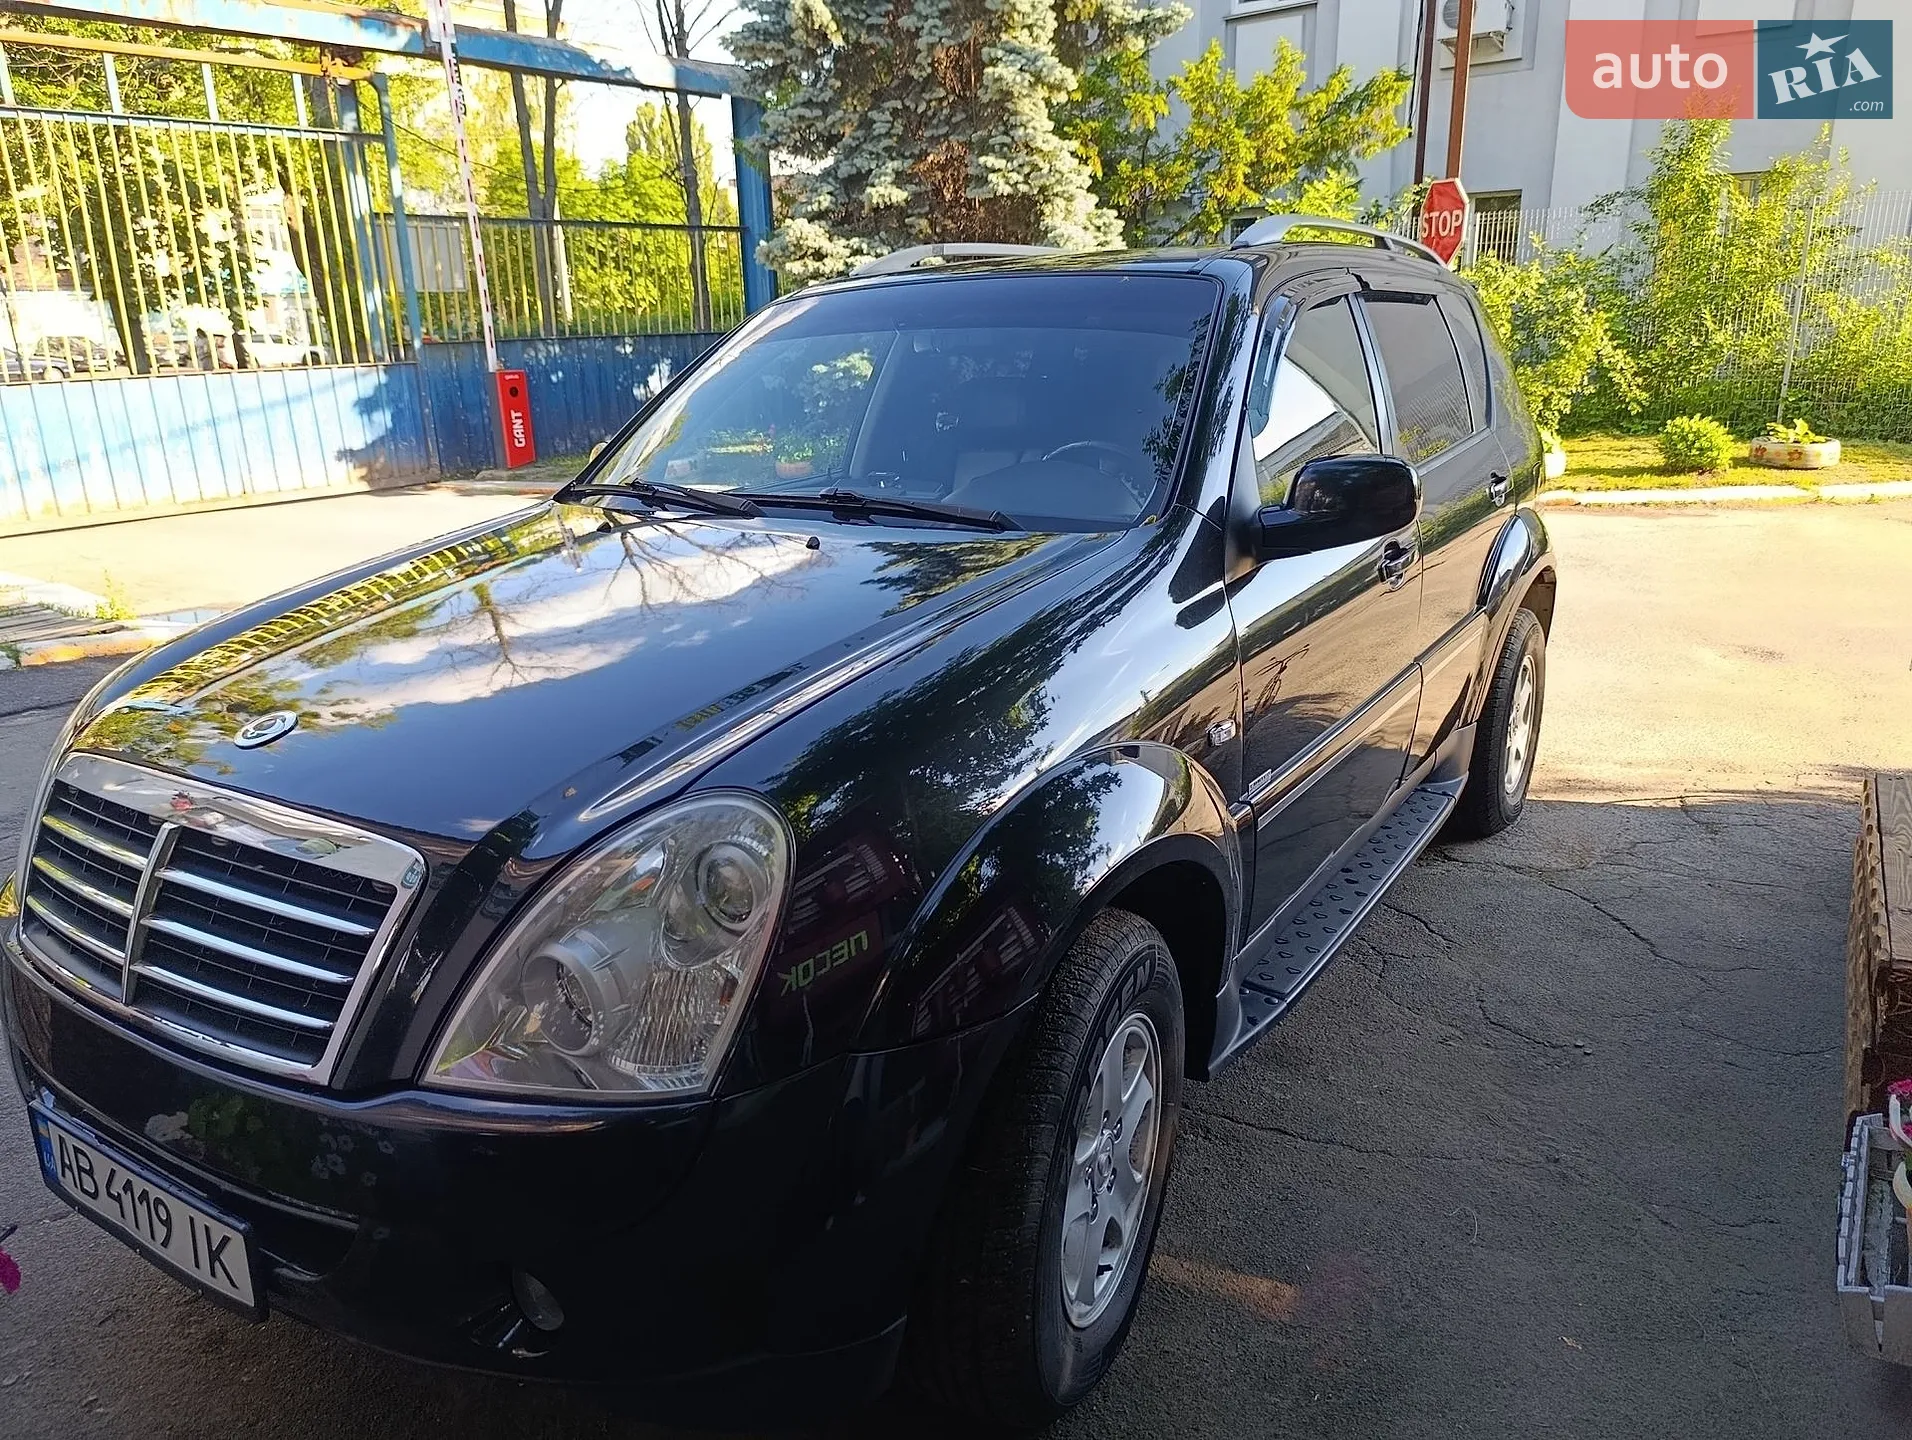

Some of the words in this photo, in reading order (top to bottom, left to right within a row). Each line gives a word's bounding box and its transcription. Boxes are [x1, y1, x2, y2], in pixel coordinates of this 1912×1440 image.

[1421, 209, 1463, 238] STOP
[510, 410, 527, 448] GANT
[58, 1134, 99, 1200] AB
[105, 1167, 173, 1249] 4119
[188, 1215, 240, 1290] IK
